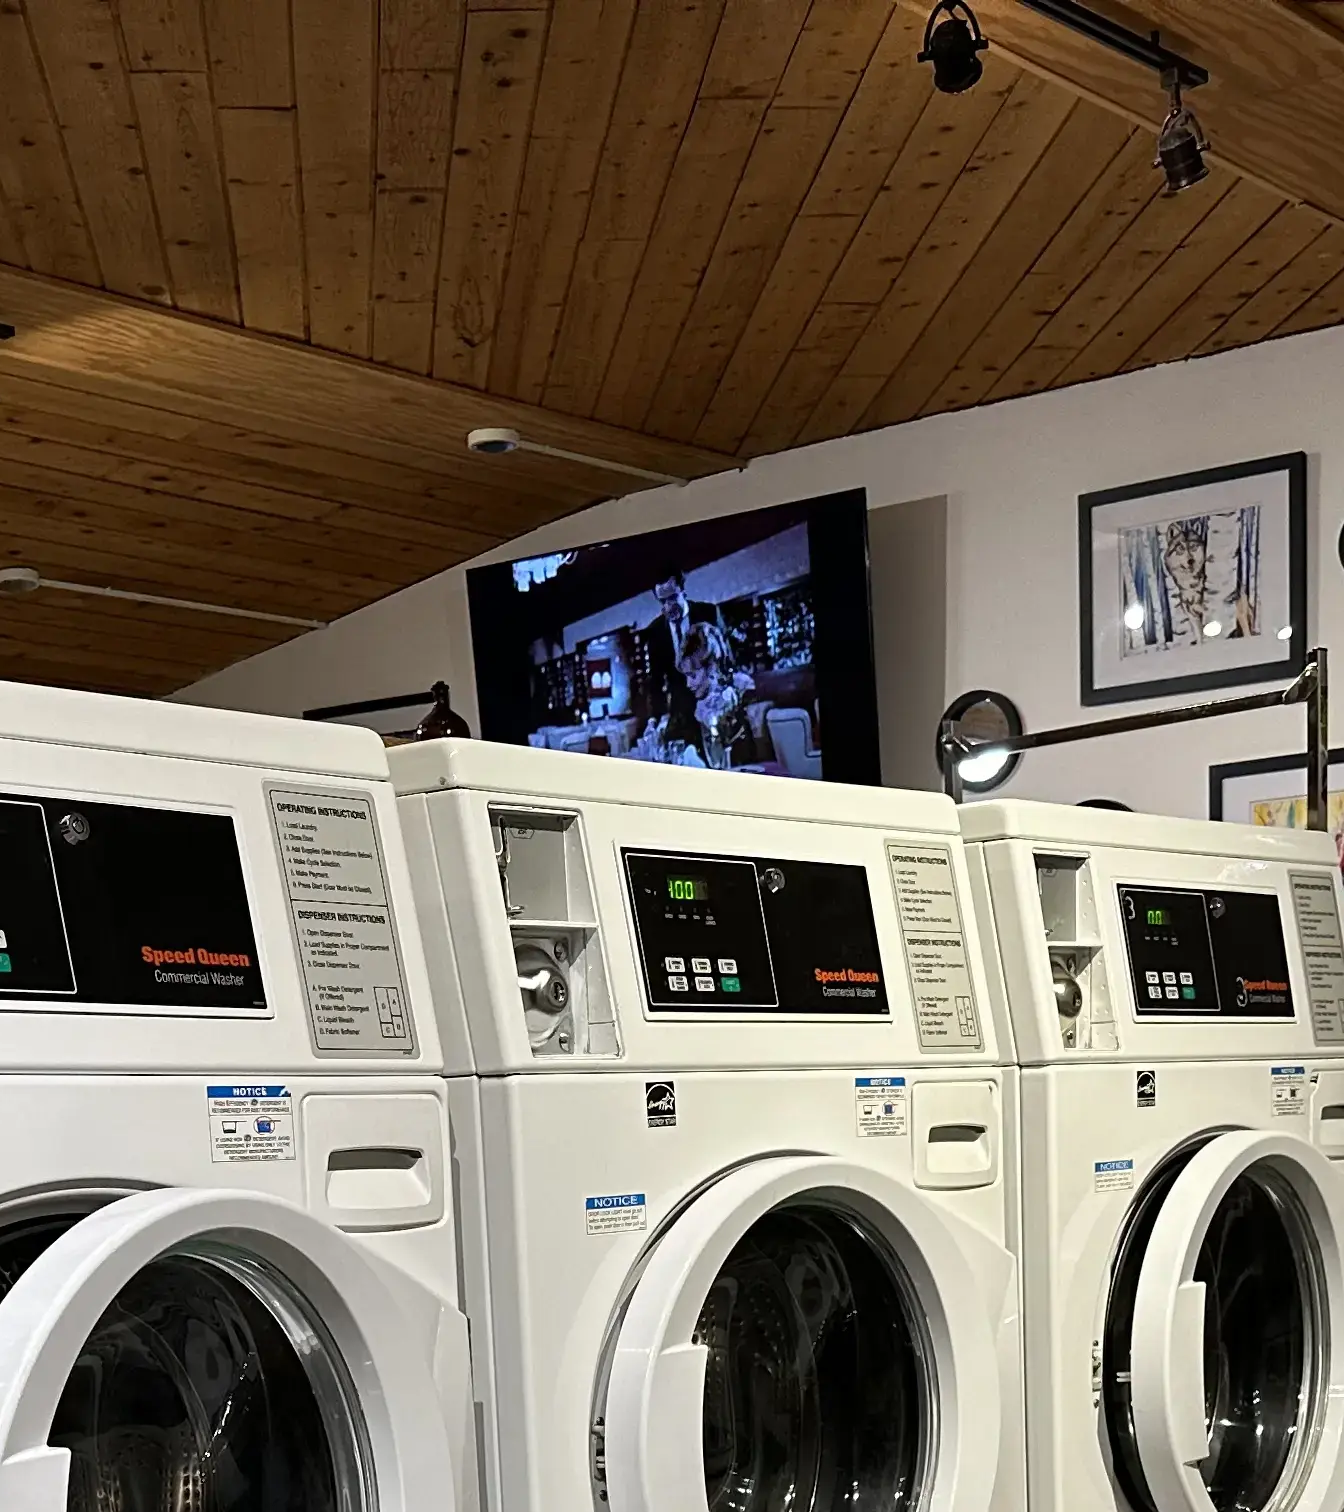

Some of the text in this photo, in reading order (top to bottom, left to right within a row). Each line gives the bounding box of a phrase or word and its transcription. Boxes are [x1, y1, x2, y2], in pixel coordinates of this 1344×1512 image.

[141, 945, 251, 967] Speed Queen
[154, 969, 245, 987] Commercial Washer
[814, 968, 880, 984] Speed Queen
[232, 1086, 268, 1097] NOTICE
[1100, 1161, 1129, 1171] NOTICE
[594, 1196, 639, 1208] NOTICE
